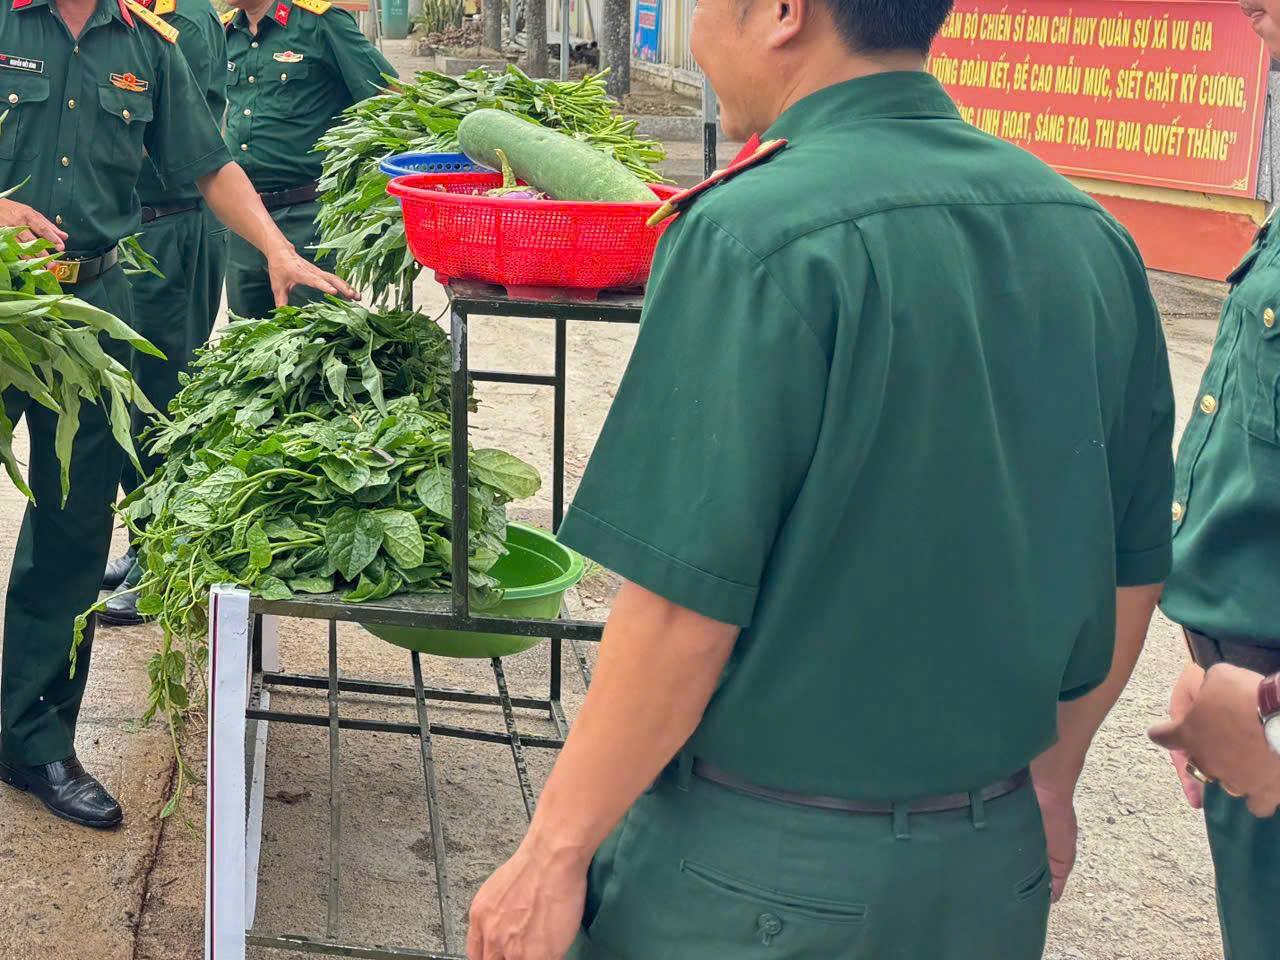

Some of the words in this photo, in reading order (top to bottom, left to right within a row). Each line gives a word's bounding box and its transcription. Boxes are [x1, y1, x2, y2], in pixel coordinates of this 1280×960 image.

[963, 6, 979, 48] BỘ
[980, 3, 1012, 41] CHIẾN
[1013, 7, 1028, 43] SĨ
[1025, 15, 1050, 44] BAN
[1050, 7, 1073, 45] CHỈ
[1072, 17, 1098, 46] HUY
[1098, 11, 1131, 49] QUÂN
[1133, 15, 1152, 56] SỰ
[1151, 12, 1170, 50] XÃ
[1171, 19, 1190, 51] VU
[1191, 20, 1213, 52] GIA
[959, 53, 989, 88] ĐOÀN
[989, 51, 1011, 95] KẾT,
[1013, 53, 1031, 91] ĐỀ
[1030, 63, 1054, 94] CAO
[1054, 55, 1082, 96] MẪU
[1083, 64, 1113, 103] MỰC,
[1116, 58, 1144, 101] SIẾT
[1144, 66, 1179, 109] CHẶT
[1179, 63, 1199, 104] KỶ
[1199, 71, 1248, 113] CƯƠNG,
[1001, 110, 1033, 146] HOẠT,
[1034, 103, 1065, 144] SÁNG
[1067, 116, 1091, 151] TẠO,
[1095, 118, 1115, 149] THI
[1116, 120, 1141, 152] ĐUA
[1143, 114, 1185, 157] QUYẾT
